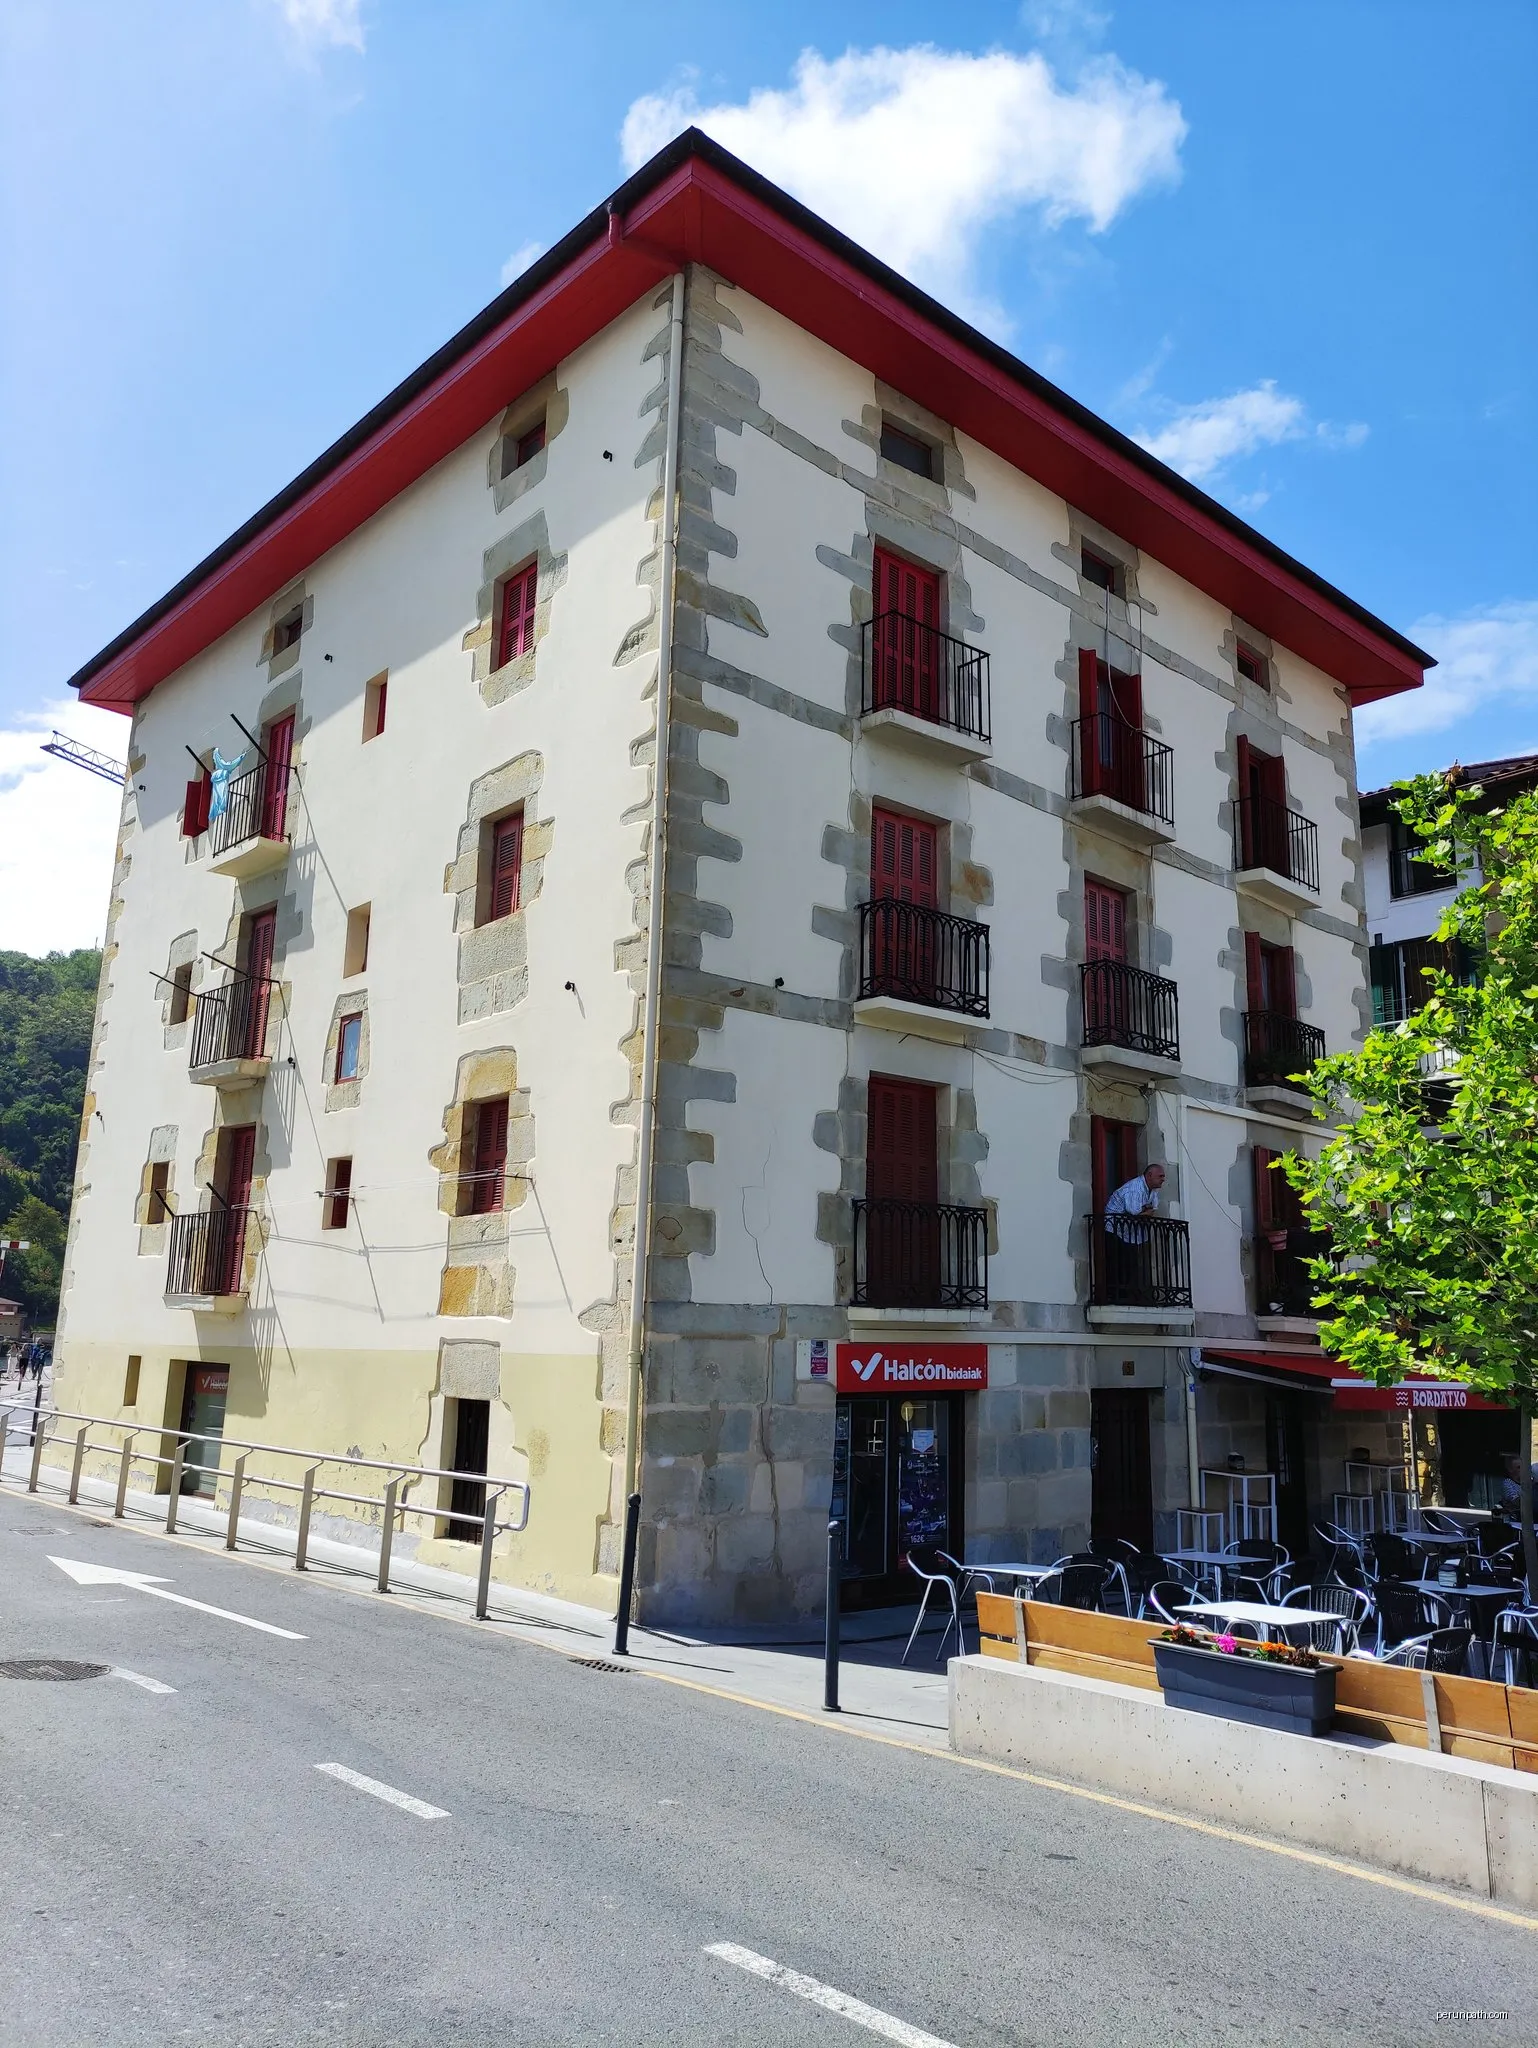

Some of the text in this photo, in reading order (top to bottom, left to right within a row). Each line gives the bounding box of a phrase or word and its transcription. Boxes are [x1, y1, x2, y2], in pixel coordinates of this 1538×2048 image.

[884, 1358, 982, 1381] Halcón bidaiak
[1412, 1390, 1467, 1407] BORDATXO
